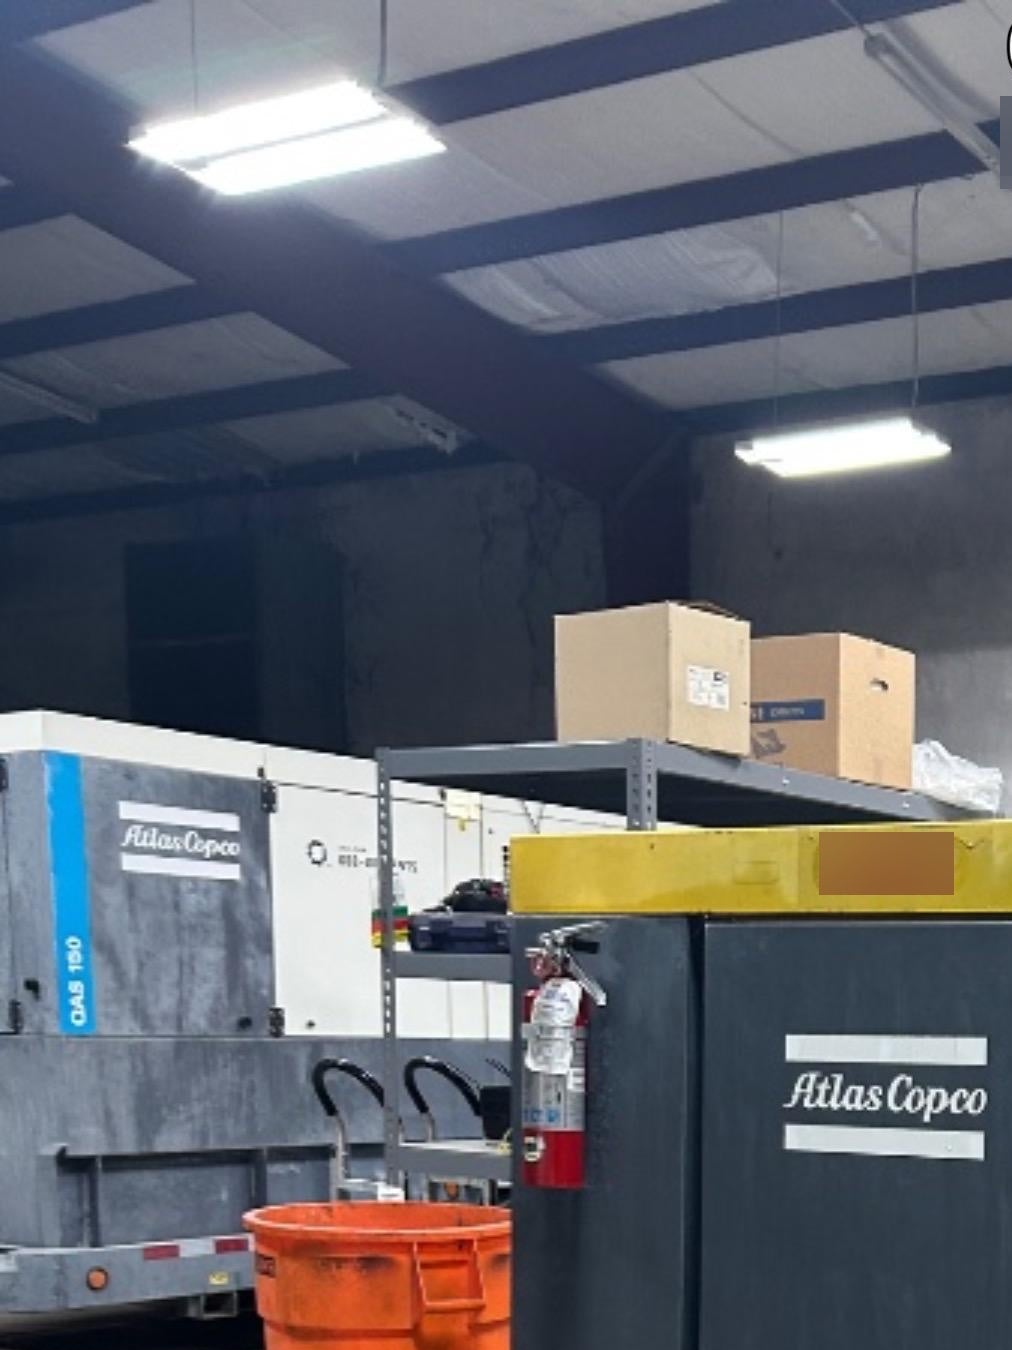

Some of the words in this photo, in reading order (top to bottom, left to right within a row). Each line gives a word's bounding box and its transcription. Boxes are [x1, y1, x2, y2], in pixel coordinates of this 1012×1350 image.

[121, 823, 181, 851] Atlas
[184, 830, 241, 858] Copco
[68, 979, 88, 1027] QAS
[783, 1070, 883, 1111] Atlas
[887, 1072, 988, 1123] Copco
